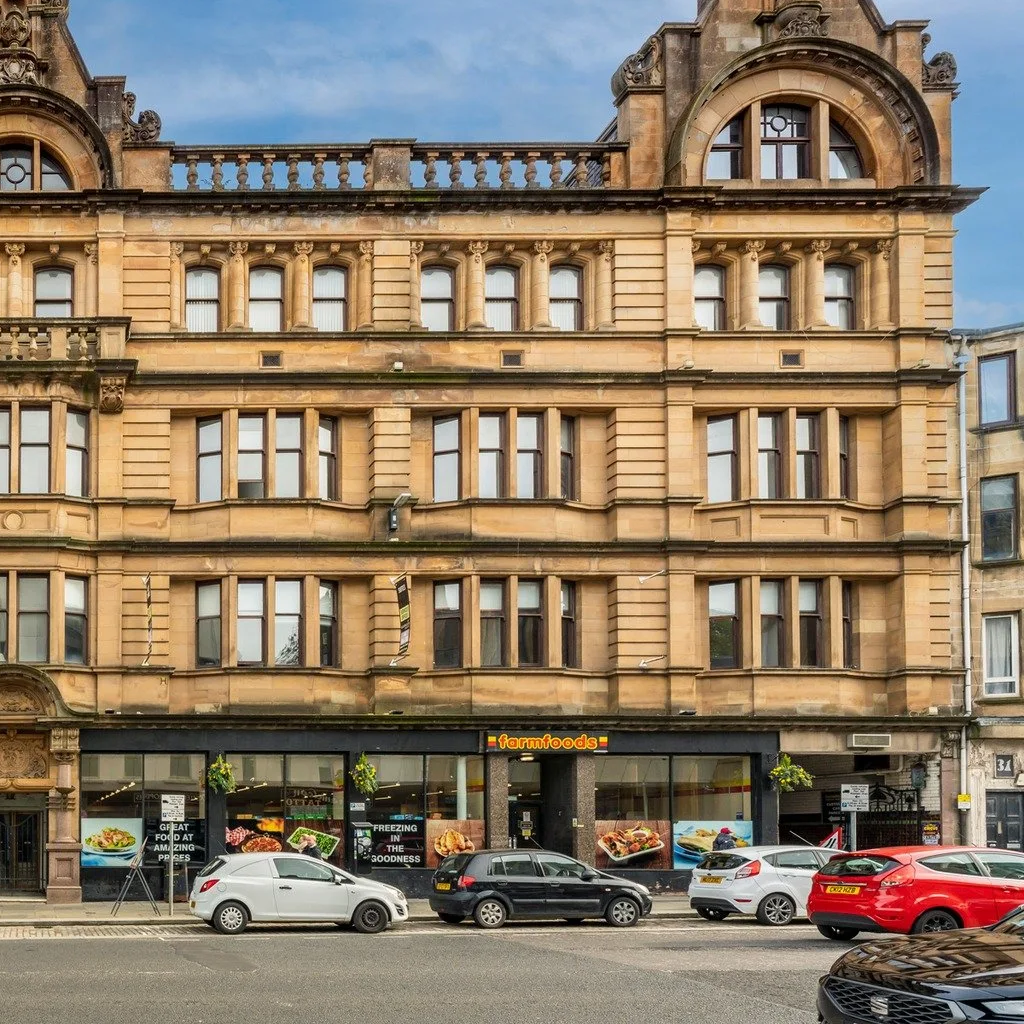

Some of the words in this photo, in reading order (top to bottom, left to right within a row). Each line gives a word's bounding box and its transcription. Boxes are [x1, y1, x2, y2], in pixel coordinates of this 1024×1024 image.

[498, 733, 597, 750] farmfoods
[373, 824, 418, 832] FREEZING
[182, 833, 194, 841] AT
[390, 834, 400, 842] IN
[386, 844, 405, 853] THE
[158, 854, 191, 862] PRCES
[371, 855, 421, 863] GOODNESS
